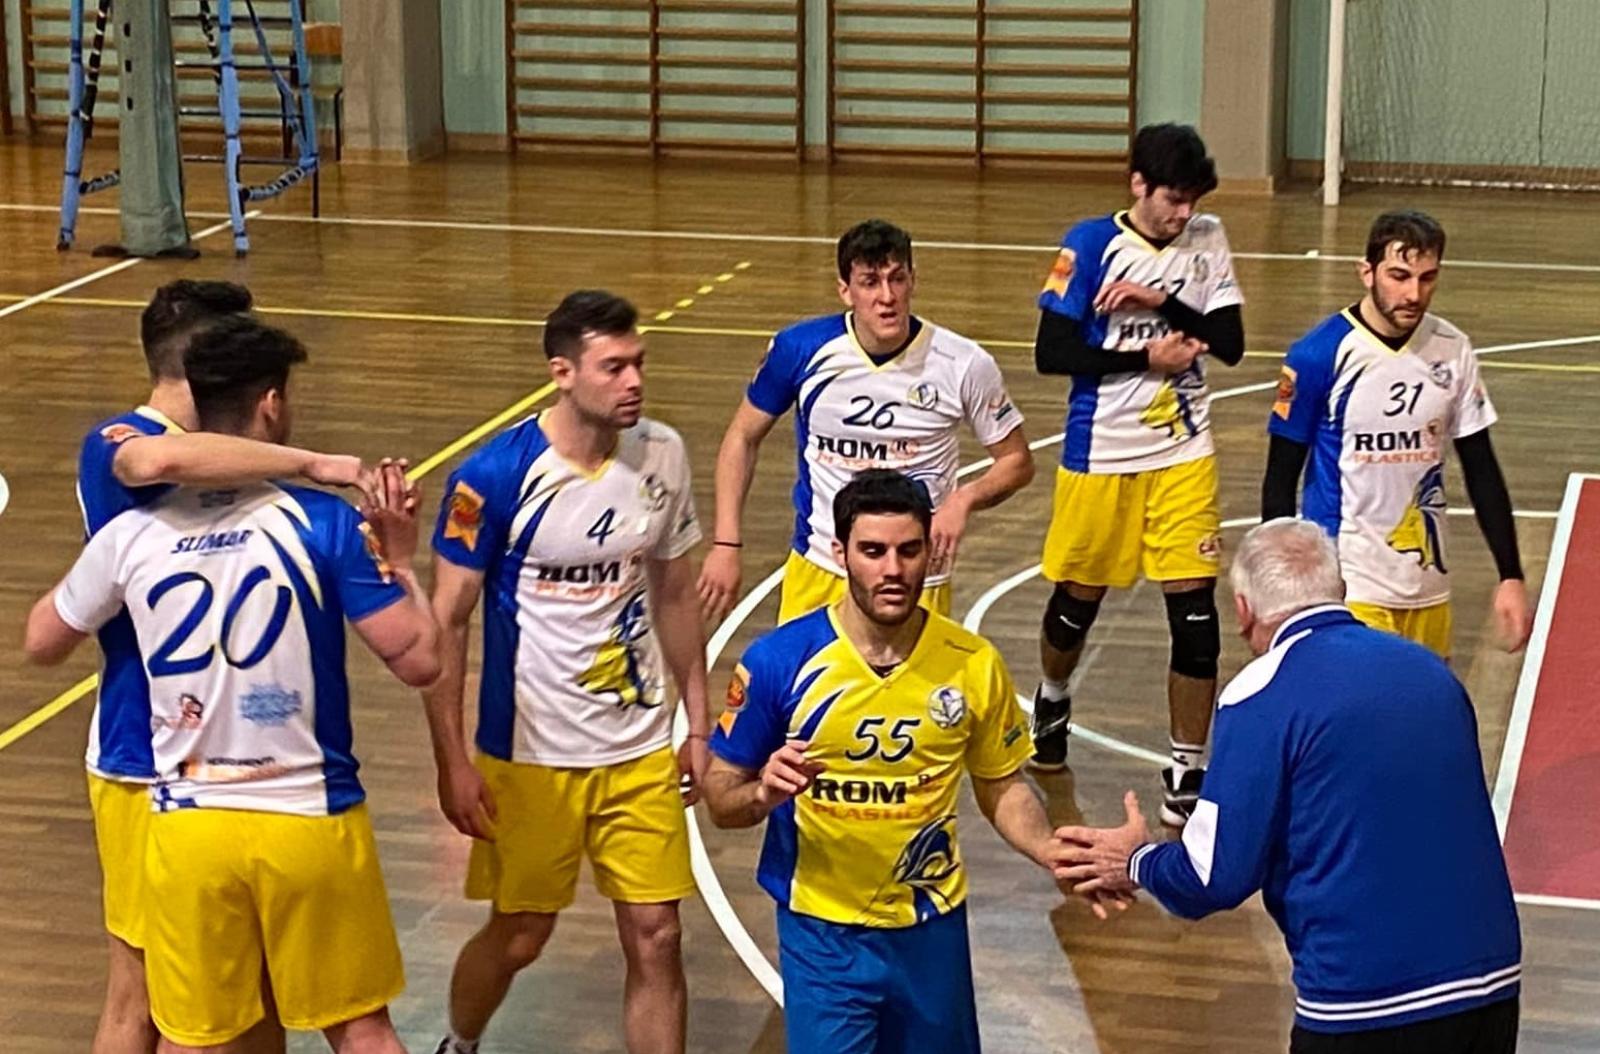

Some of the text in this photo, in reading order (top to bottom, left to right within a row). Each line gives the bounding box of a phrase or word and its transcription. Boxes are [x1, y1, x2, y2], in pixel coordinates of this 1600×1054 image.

[842, 395, 901, 430] 26
[1383, 381, 1424, 417] 31
[816, 434, 888, 461] ROM
[1355, 430, 1421, 451] ROM
[587, 508, 618, 546] 4
[147, 564, 292, 678] 20
[844, 717, 921, 763] 55
[812, 778, 907, 805] ROM
